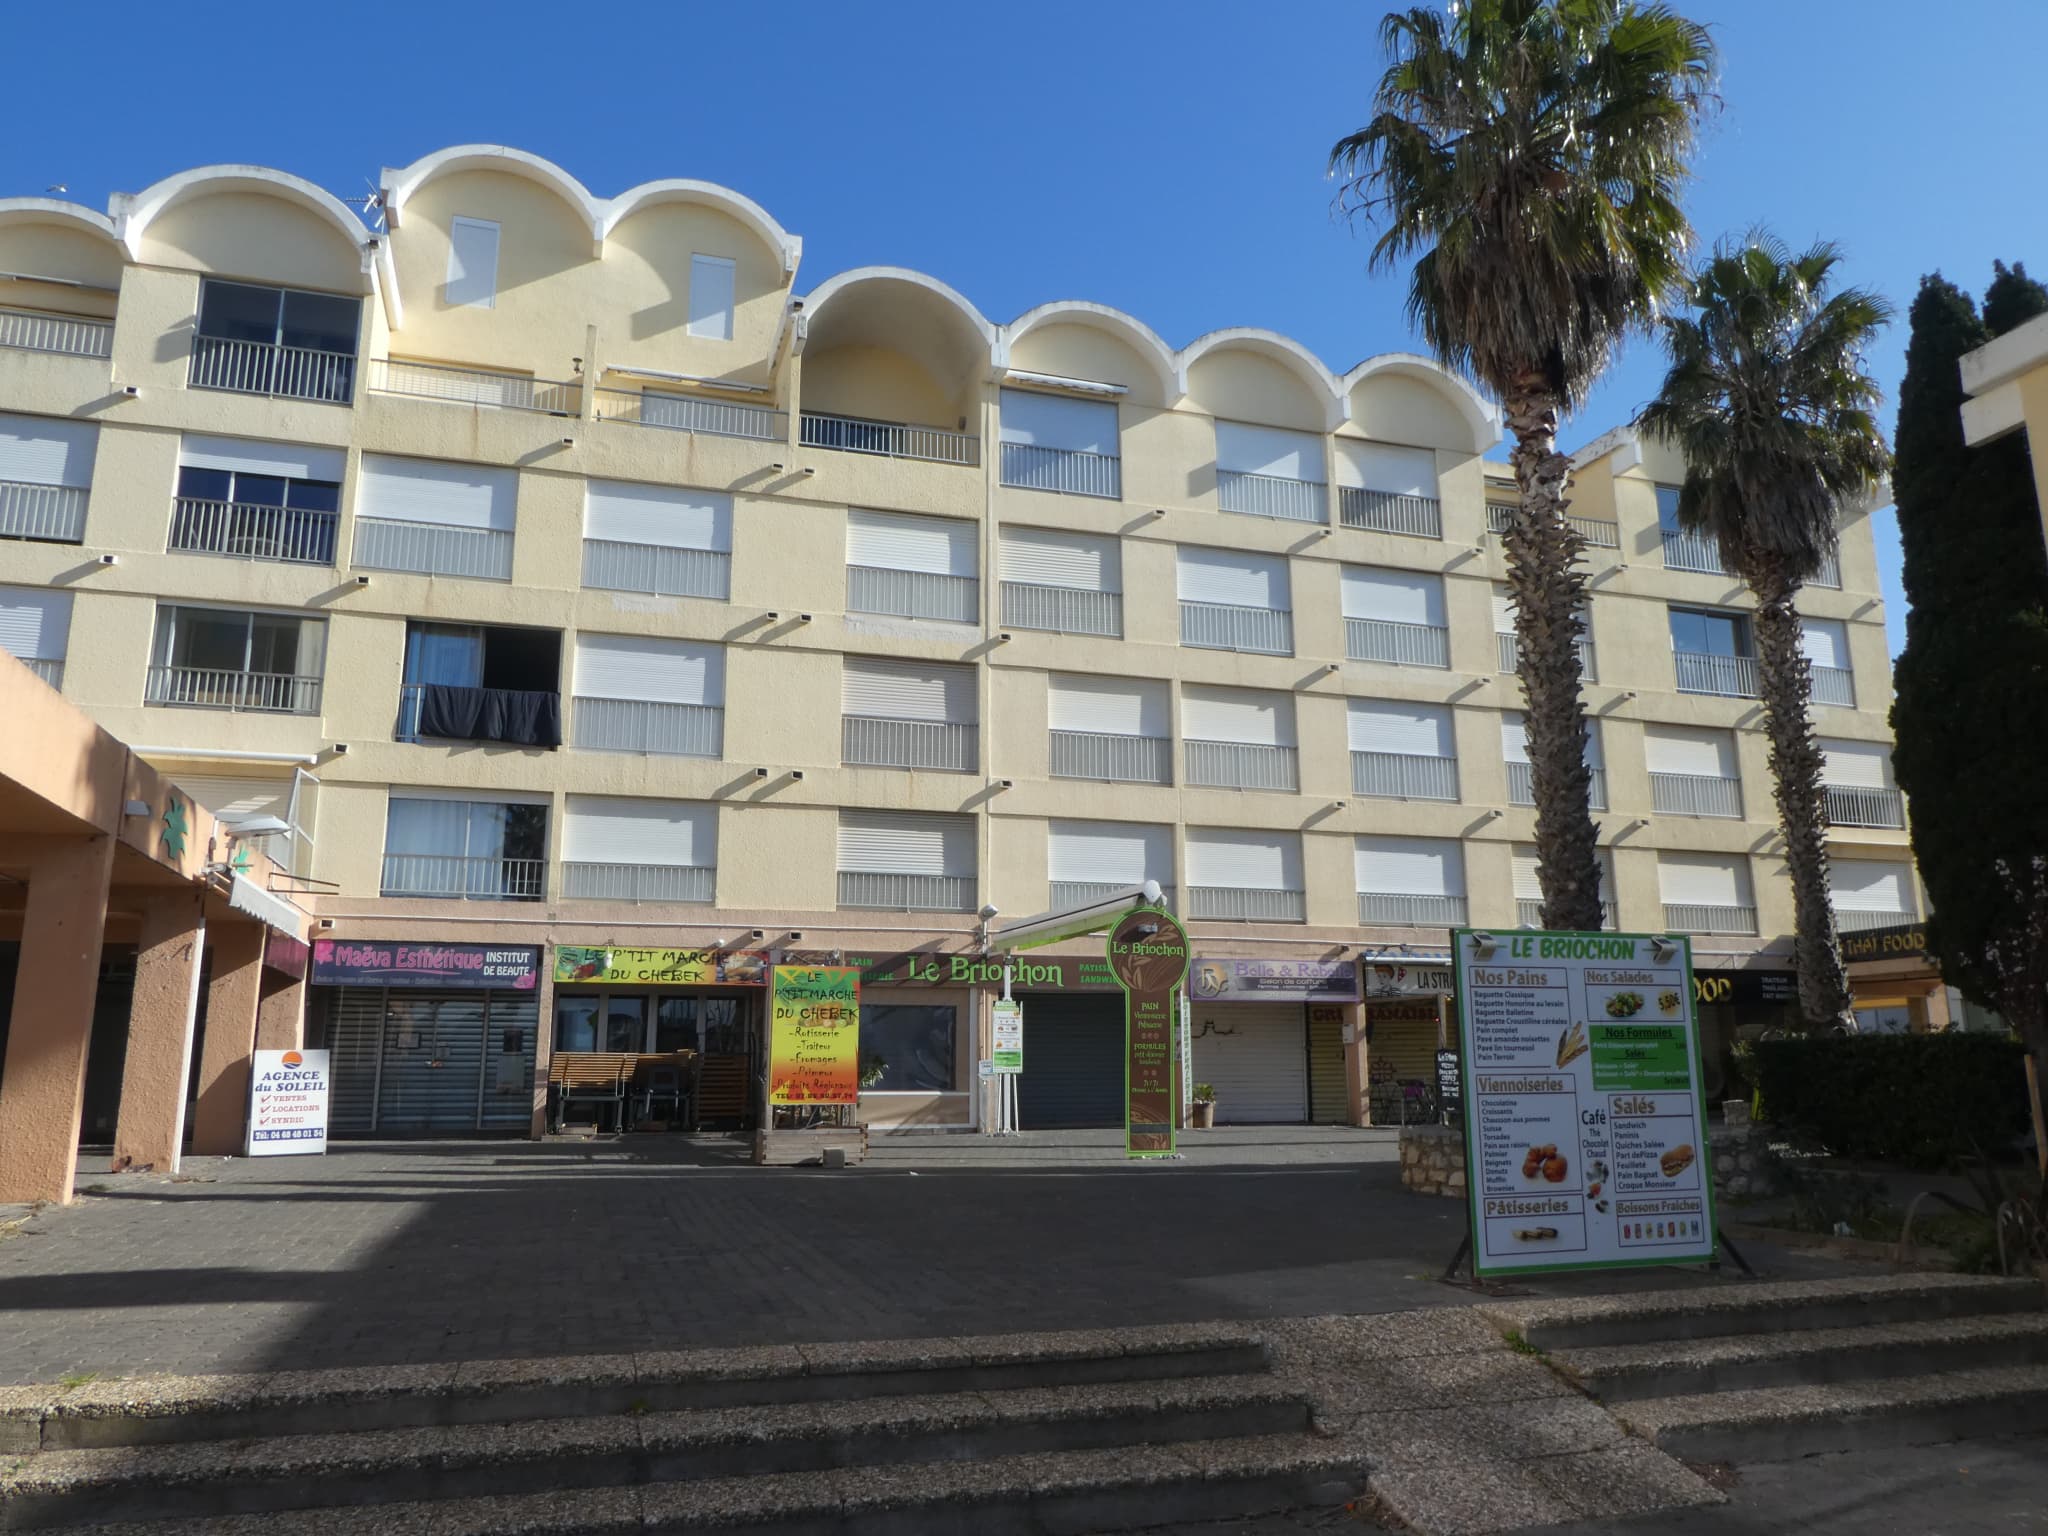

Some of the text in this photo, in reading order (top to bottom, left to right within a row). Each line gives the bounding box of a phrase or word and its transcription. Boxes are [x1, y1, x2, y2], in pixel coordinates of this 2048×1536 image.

[1883, 933, 1925, 952] FOOD
[1112, 941, 1184, 957] Le Briochon
[1511, 938, 1635, 960] LE BRIOCHON
[336, 946, 483, 969] Maëva Esthétique
[486, 951, 530, 963] INSTITUT
[584, 948, 606, 961] LE
[612, 949, 658, 962] P'TIT
[483, 966, 530, 976] DE BEAUTE
[907, 956, 1065, 987] Le Briochon
[1080, 963, 1111, 972] PATISS
[1235, 962, 1353, 977] Belle & Rebelle
[611, 970, 705, 982] DU CHEBEK
[808, 972, 822, 982] LE
[1080, 975, 1118, 983] SANDWI
[1417, 972, 1455, 989] LA STRA
[1475, 969, 1547, 986] Nos Pains
[1586, 971, 1654, 983] Nos Salades
[810, 989, 858, 1000] MARCHE
[1693, 977, 1731, 1002] OOD
[1474, 991, 1535, 999] Baguette Classique
[1475, 1000, 1504, 1008] Baguette
[777, 1008, 858, 1020] DU CHEBEK
[1475, 1009, 1504, 1017] Baguette
[1476, 1018, 1505, 1026] Baguette
[1606, 1028, 1672, 1038] Nos Formules
[263, 1071, 320, 1080] AGENCE
[255, 1082, 326, 1092] du SOLEIL
[1479, 1077, 1563, 1092] Viennoiseries
[1613, 1096, 1655, 1114] Salés
[271, 1116, 304, 1124] SYNDIC
[1581, 1109, 1606, 1125] Café
[1614, 1121, 1646, 1129] Sandwich
[271, 1131, 280, 1139] 04
[303, 1130, 312, 1138] 01
[1589, 1128, 1601, 1137] Thé
[1614, 1131, 1639, 1139] Paninis
[1582, 1140, 1609, 1148] Chocolat
[1615, 1142, 1643, 1150] Quiches
[1586, 1149, 1606, 1158] Chaud
[1634, 1171, 1658, 1180] Bagnat
[1618, 1182, 1643, 1190] Croque
[1487, 1198, 1568, 1215] Pâtisseries
[1616, 1202, 1659, 1213] Boissons
